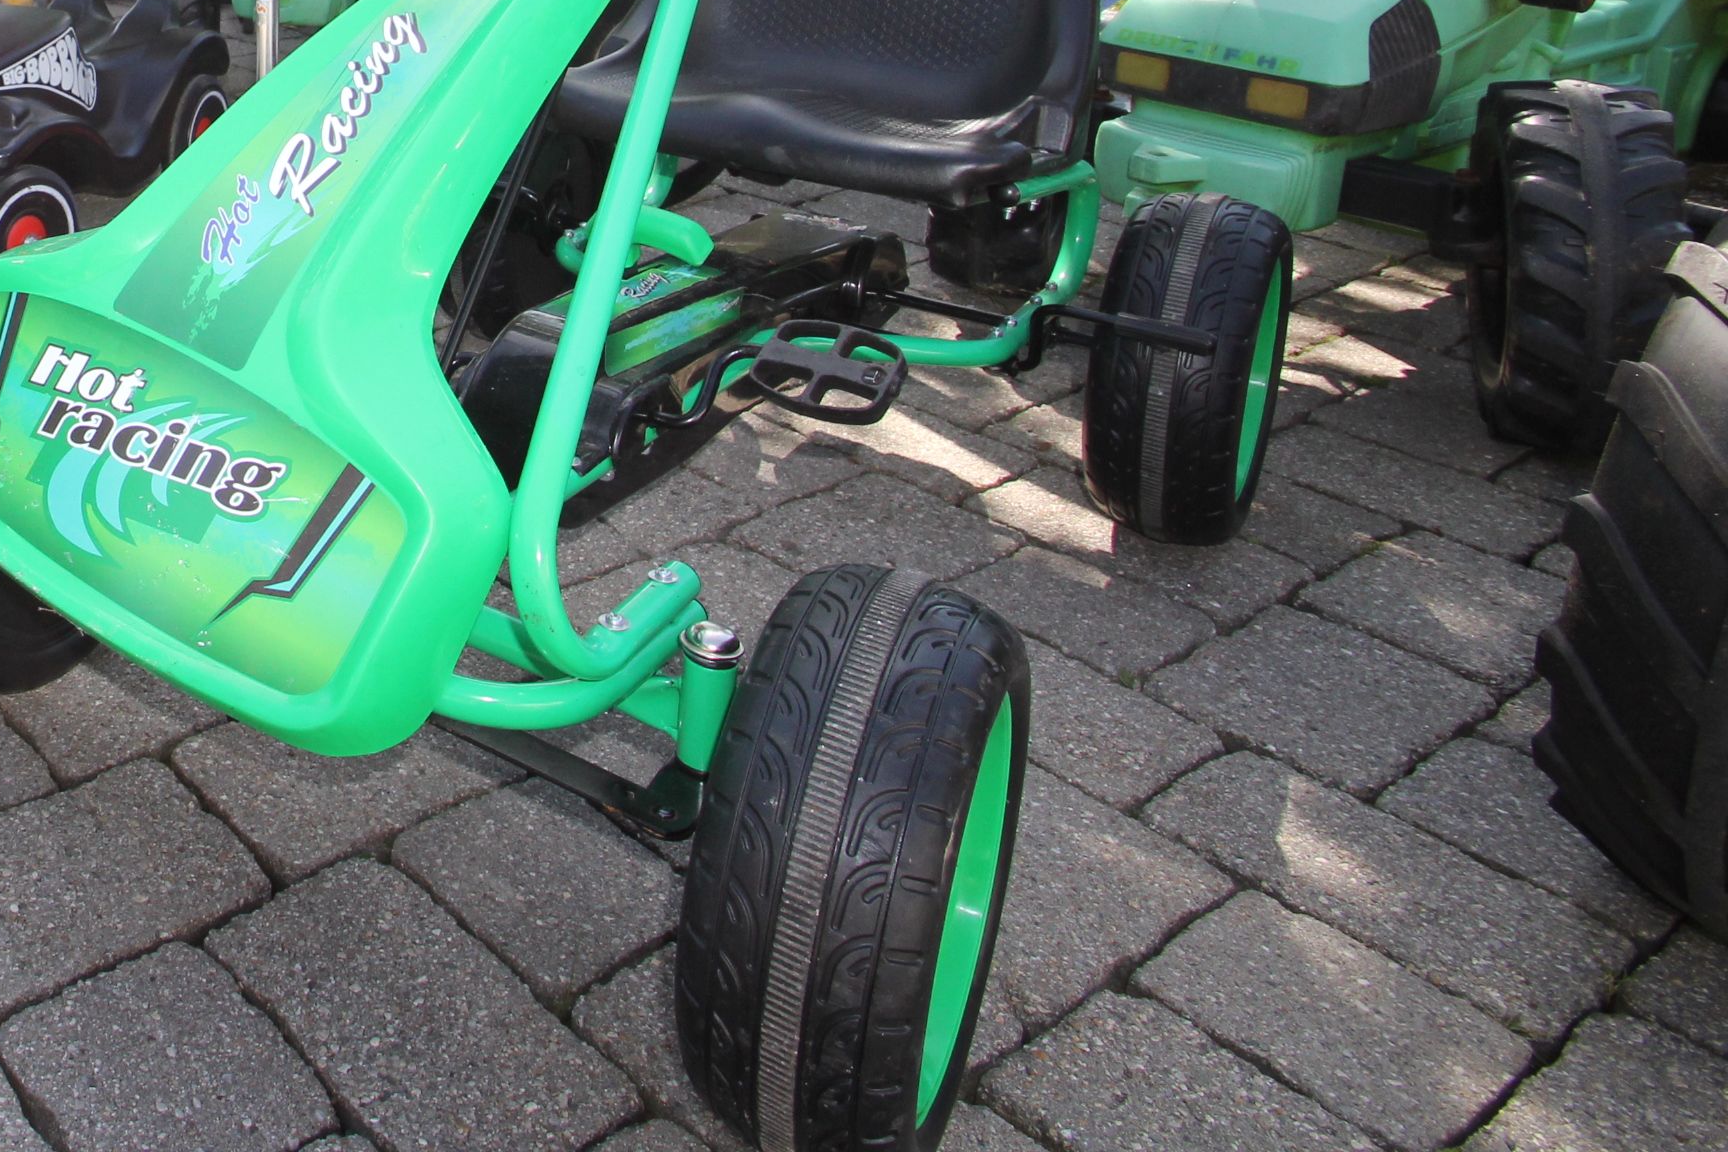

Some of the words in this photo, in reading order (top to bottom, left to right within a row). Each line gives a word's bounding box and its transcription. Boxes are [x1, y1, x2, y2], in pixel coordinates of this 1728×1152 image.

[201, 173, 260, 266] Hot
[269, 12, 428, 218] Racing
[28, 343, 148, 414] Hot
[37, 395, 287, 517] racing
